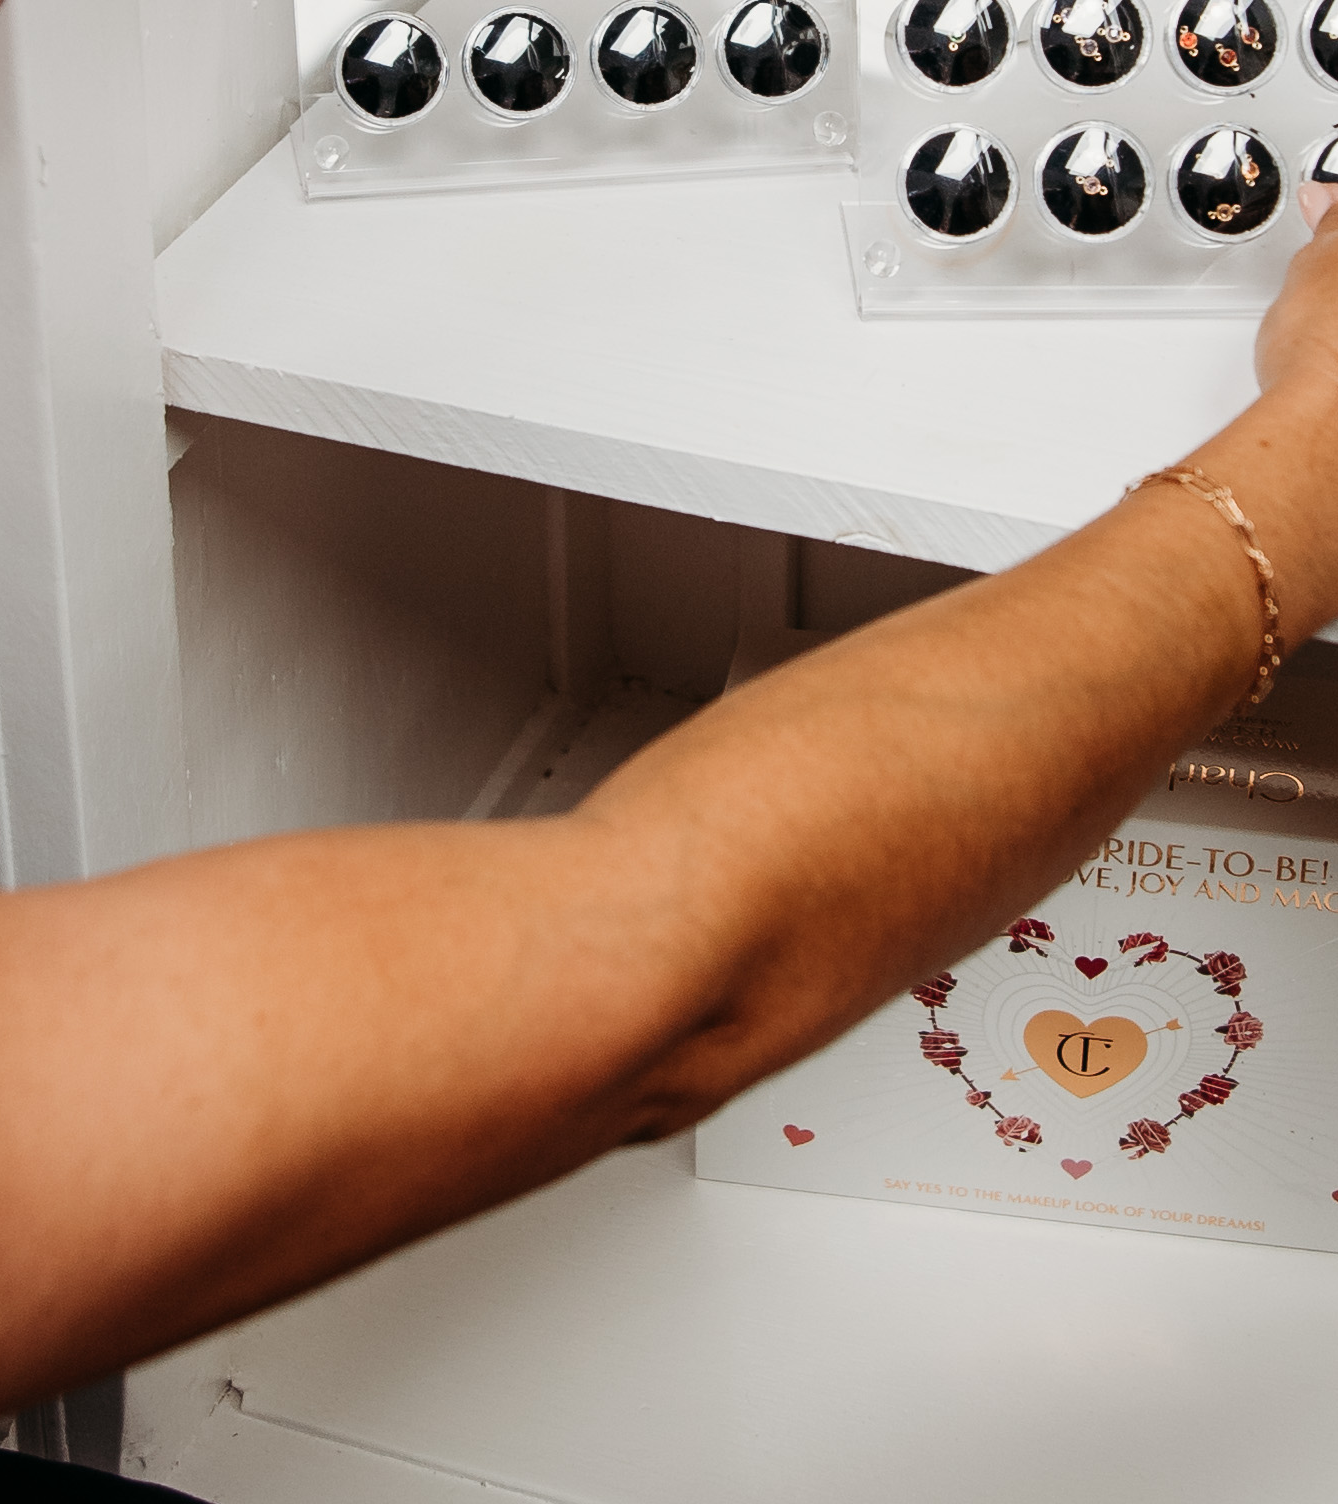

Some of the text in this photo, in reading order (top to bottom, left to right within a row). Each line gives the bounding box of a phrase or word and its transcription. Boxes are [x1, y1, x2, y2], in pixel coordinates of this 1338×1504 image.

[1126, 871, 1185, 898] JOY
[1194, 879, 1261, 904] AND
[884, 1177, 1266, 1232] SAY YES TO THE MAKEUP LOOK OF YOUR DREAMS!
